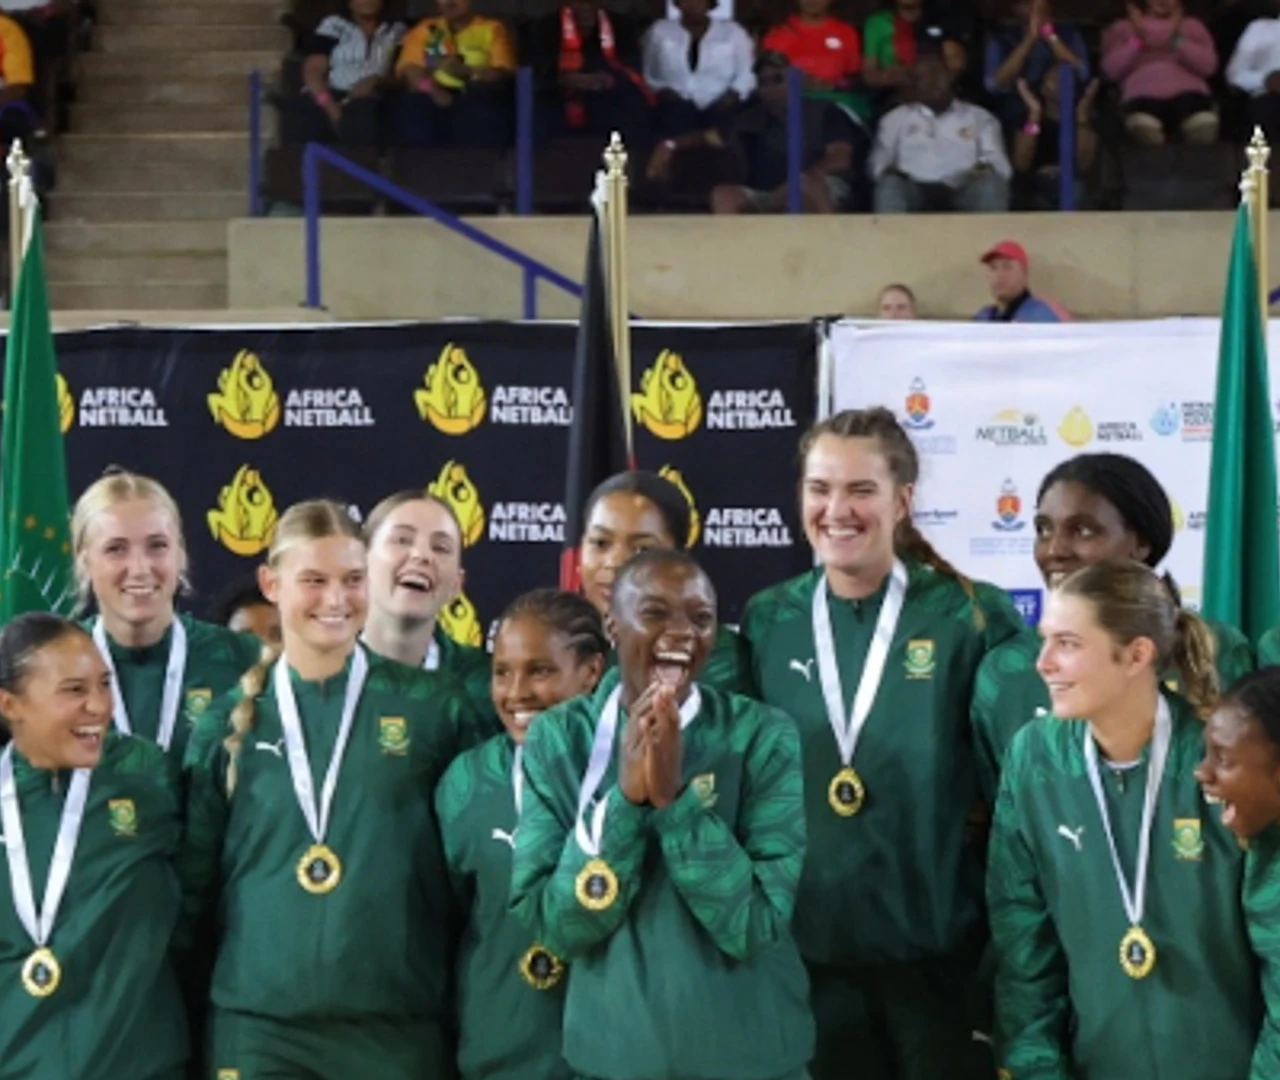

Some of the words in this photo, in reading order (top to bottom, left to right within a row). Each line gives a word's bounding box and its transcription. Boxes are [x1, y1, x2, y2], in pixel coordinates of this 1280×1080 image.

[80, 388, 156, 407] AFRICA
[286, 388, 362, 407] AFRICA
[492, 386, 568, 405] AFRICA
[708, 390, 785, 409] AFRICA
[79, 406, 168, 427] NETBALL
[284, 406, 375, 427] NETBALL
[707, 409, 796, 429] NETBALL
[490, 502, 568, 522] AFRICA
[705, 508, 782, 527] AFRICA
[489, 522, 566, 542] NETBAL
[703, 527, 793, 547] NETBALL
